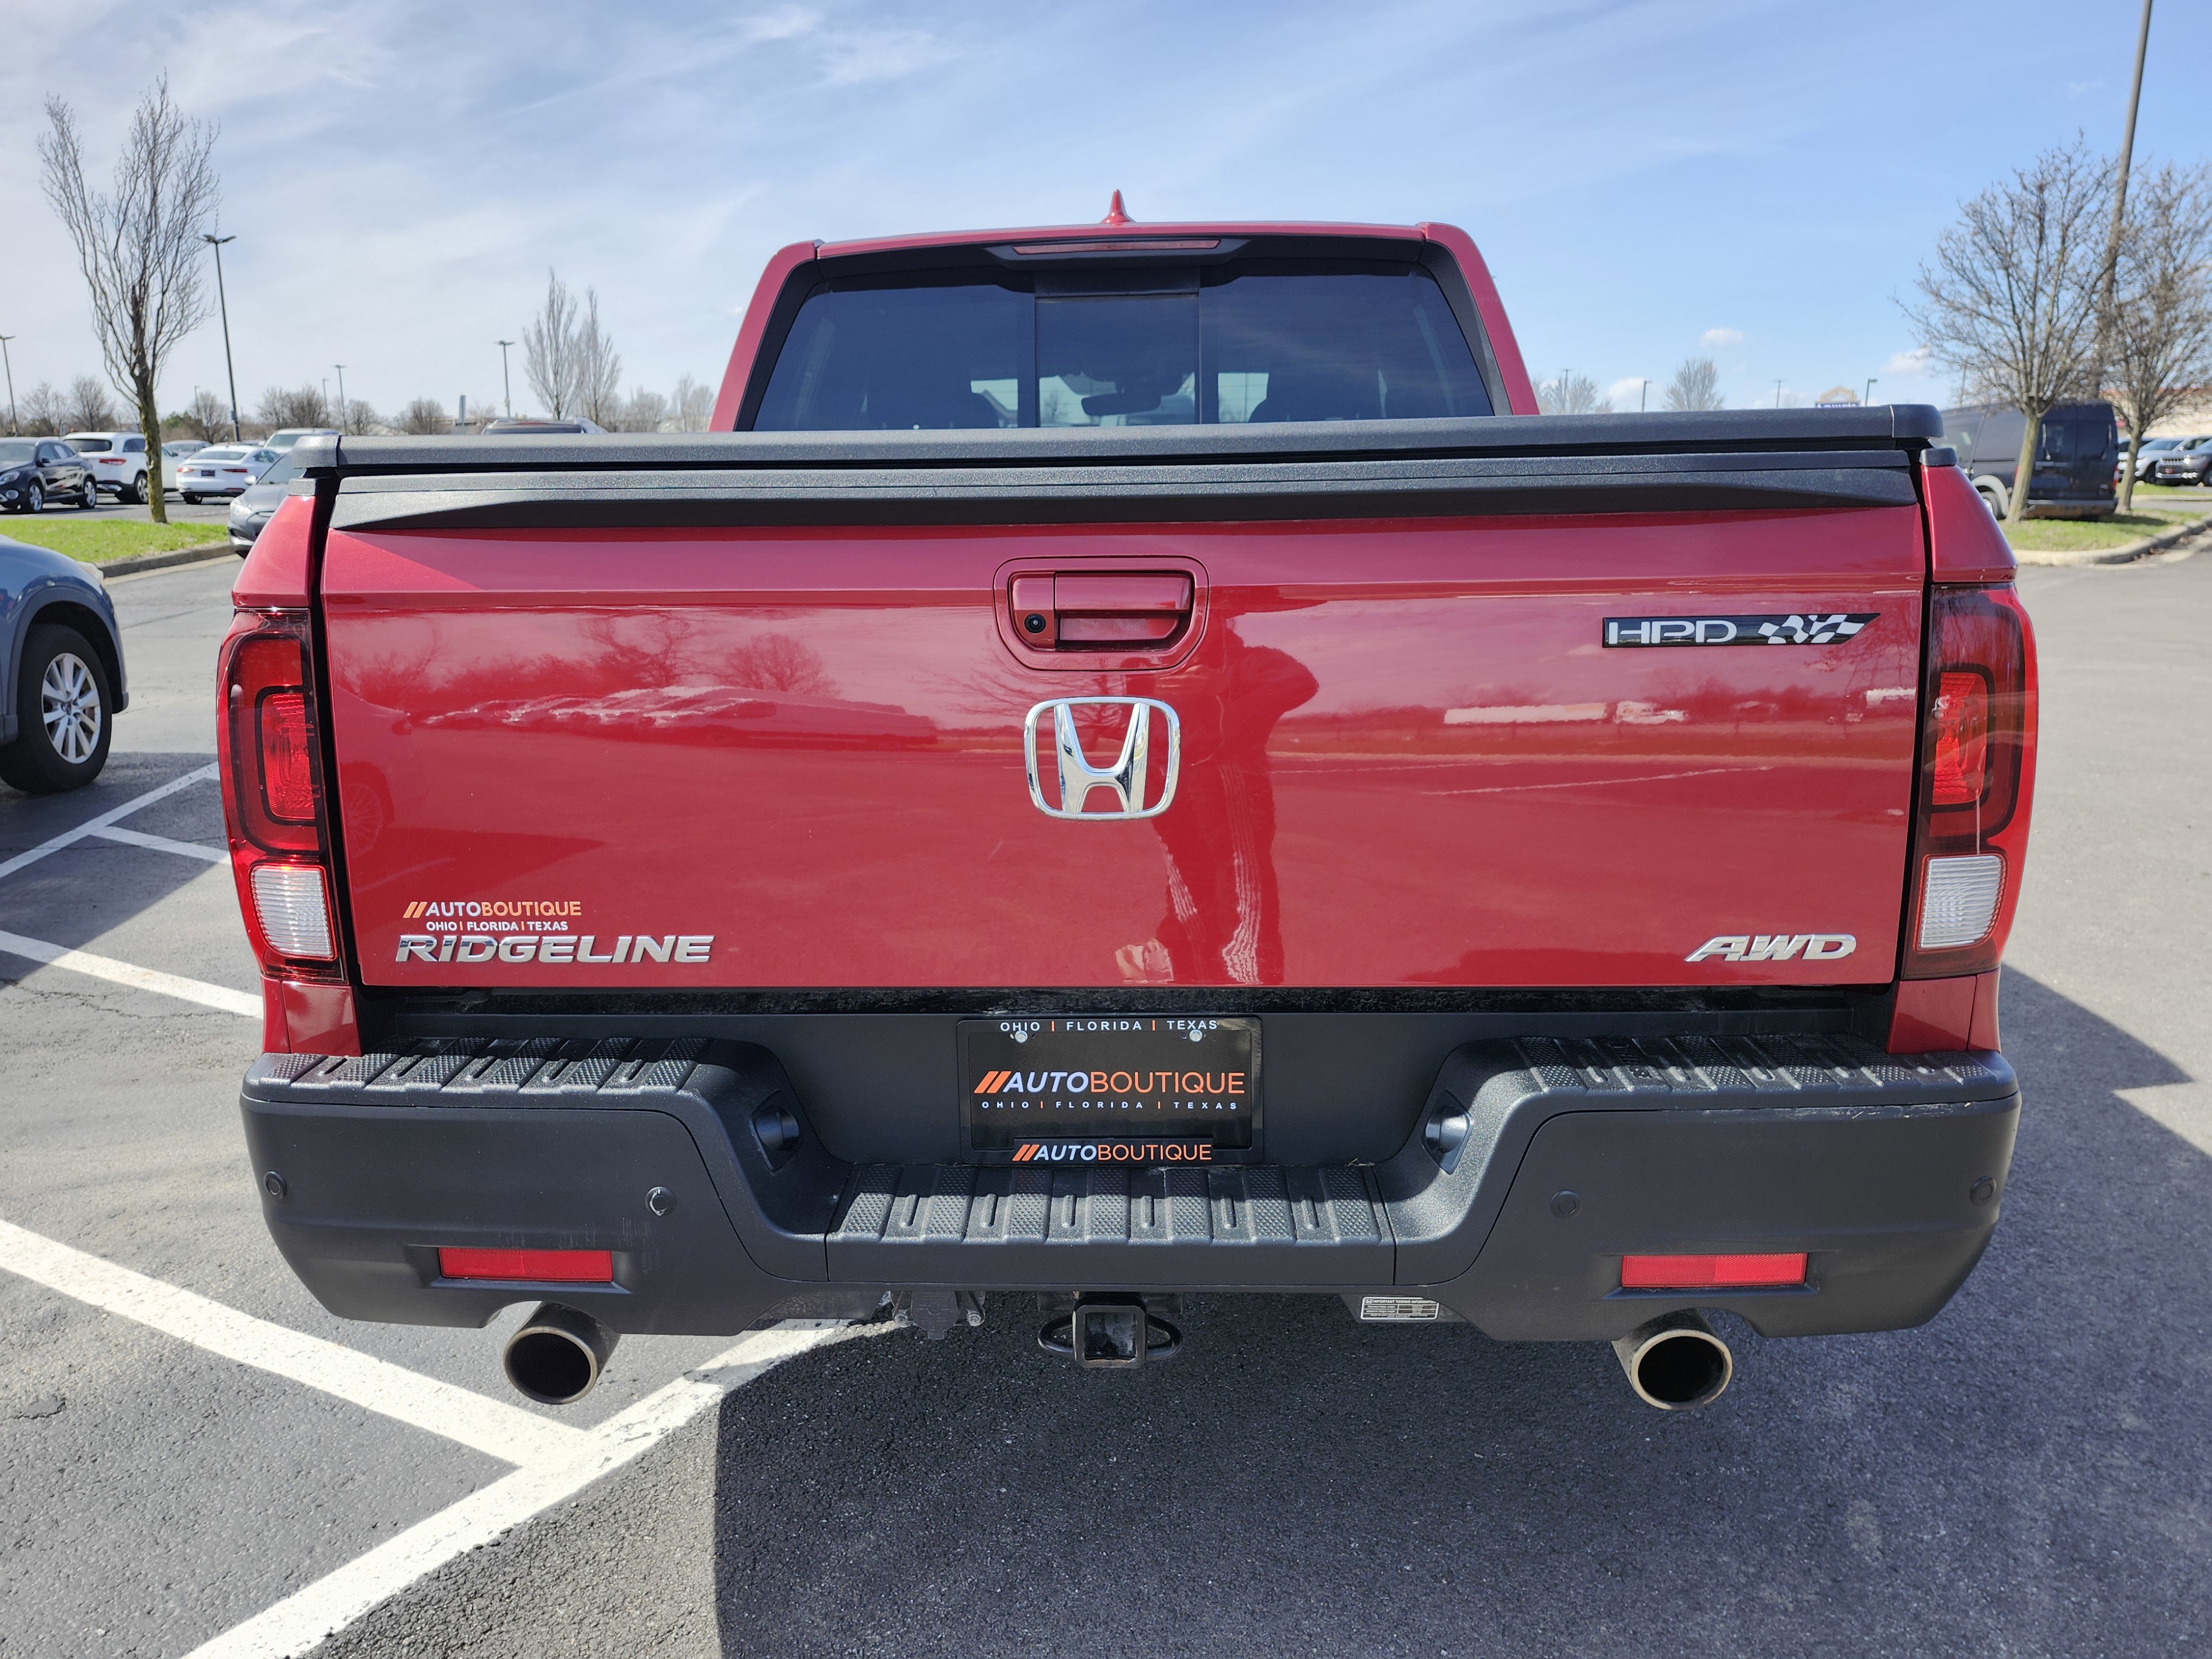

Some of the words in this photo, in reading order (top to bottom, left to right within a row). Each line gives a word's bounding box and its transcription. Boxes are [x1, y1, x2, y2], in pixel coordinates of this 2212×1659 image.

[1608, 619, 1738, 644] HPD
[425, 901, 582, 916] AUTOBOUTIQUE
[426, 921, 457, 931] OHIO
[467, 921, 519, 931] FLORIDA
[527, 921, 568, 931] TEXAS
[395, 935, 714, 963] RIDGELINE
[1684, 934, 1856, 962] AWD
[1000, 1021, 1040, 1031] OHIO
[1066, 1021, 1142, 1031] FLORIDA
[1167, 1020, 1217, 1030] TEXAS
[1003, 1072, 1245, 1093] AUTOBOUTIQUE
[1033, 1144, 1212, 1161] AUTOBOUTIQUE
